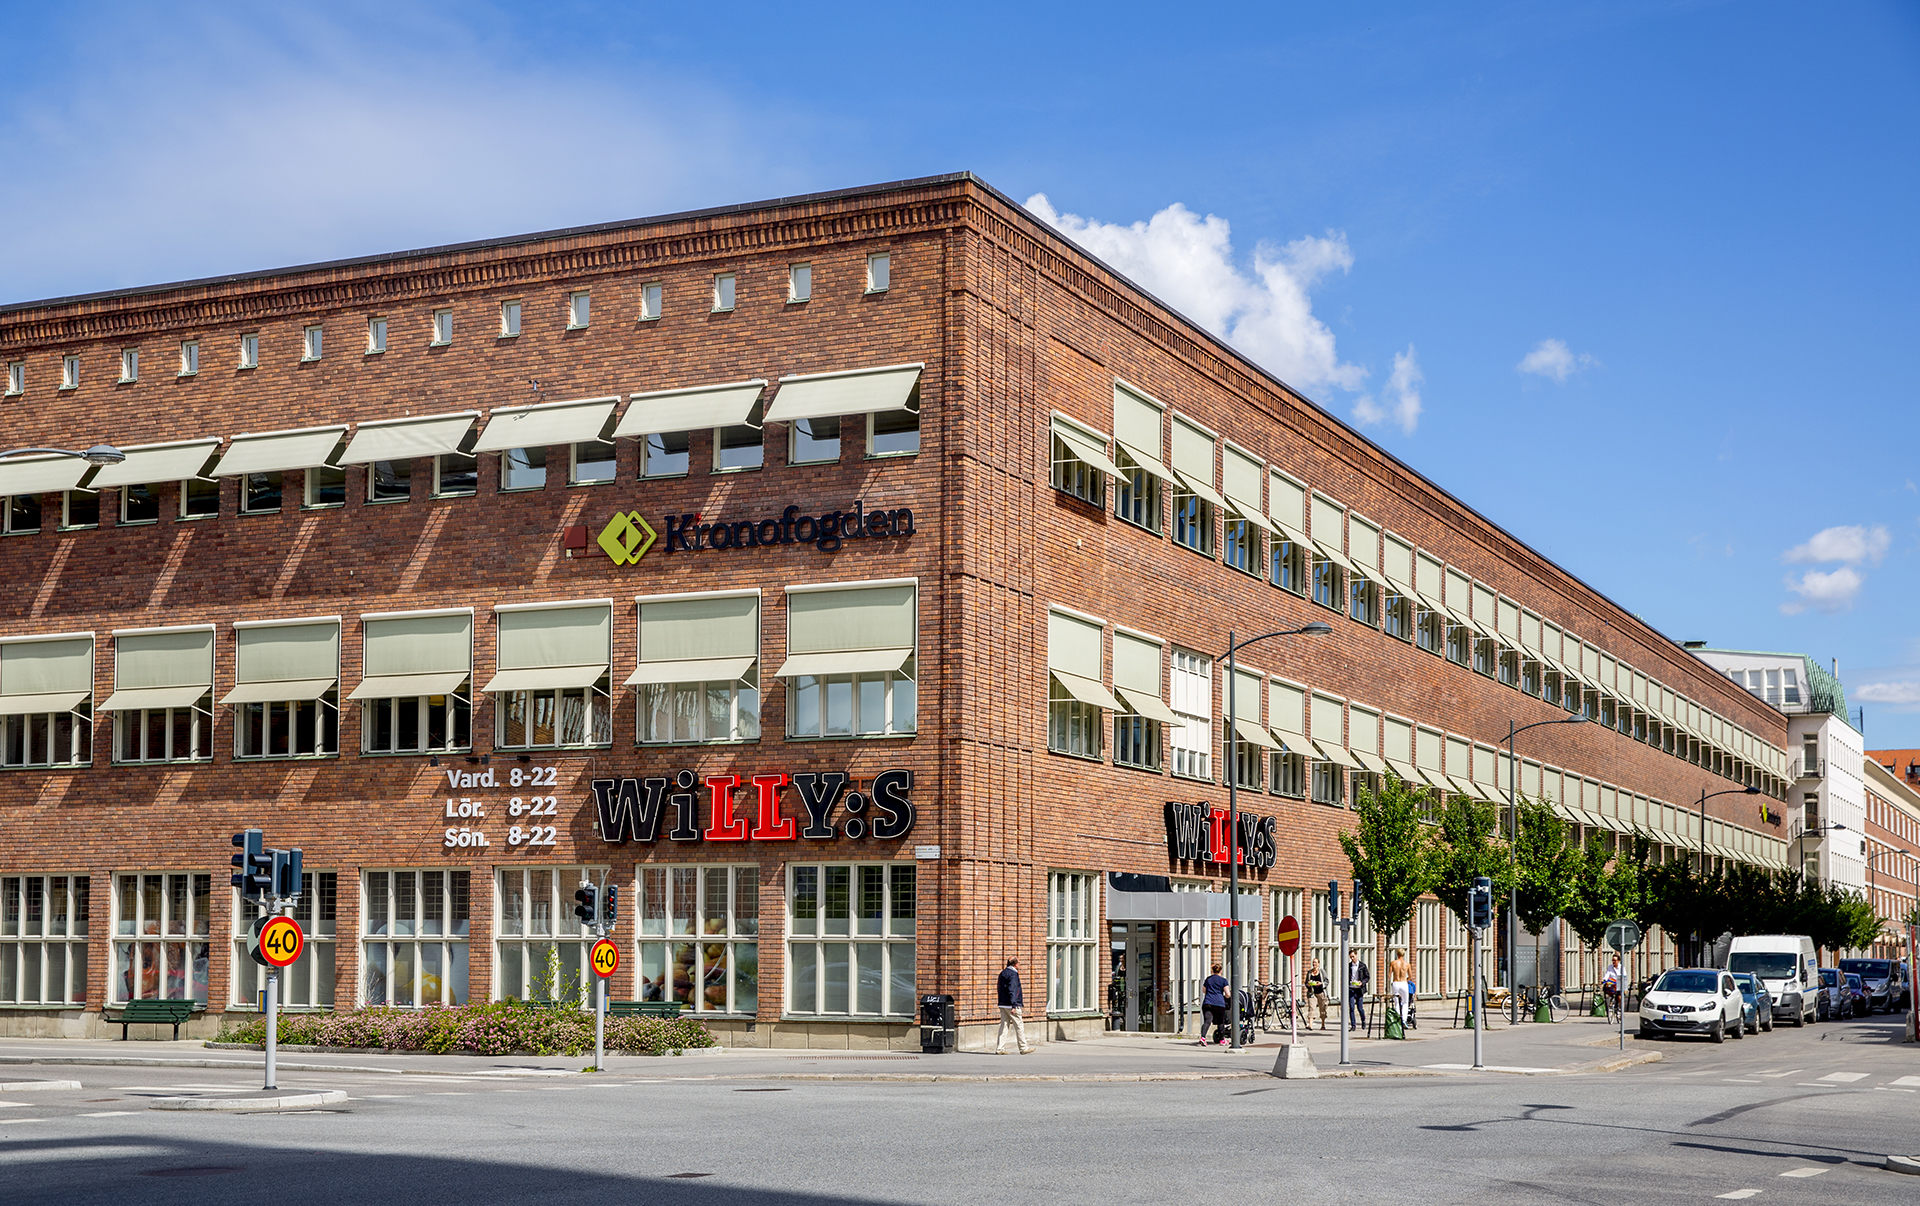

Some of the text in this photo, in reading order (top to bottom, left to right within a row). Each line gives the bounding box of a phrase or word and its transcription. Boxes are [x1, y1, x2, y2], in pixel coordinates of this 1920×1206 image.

[663, 500, 917, 553] Kronofogden
[446, 766, 558, 788] Vard. 8-22
[446, 796, 557, 818] Lör. 8-22
[444, 826, 557, 847] Sön. 8-22
[266, 929, 298, 954] 40
[595, 948, 616, 968] 40
